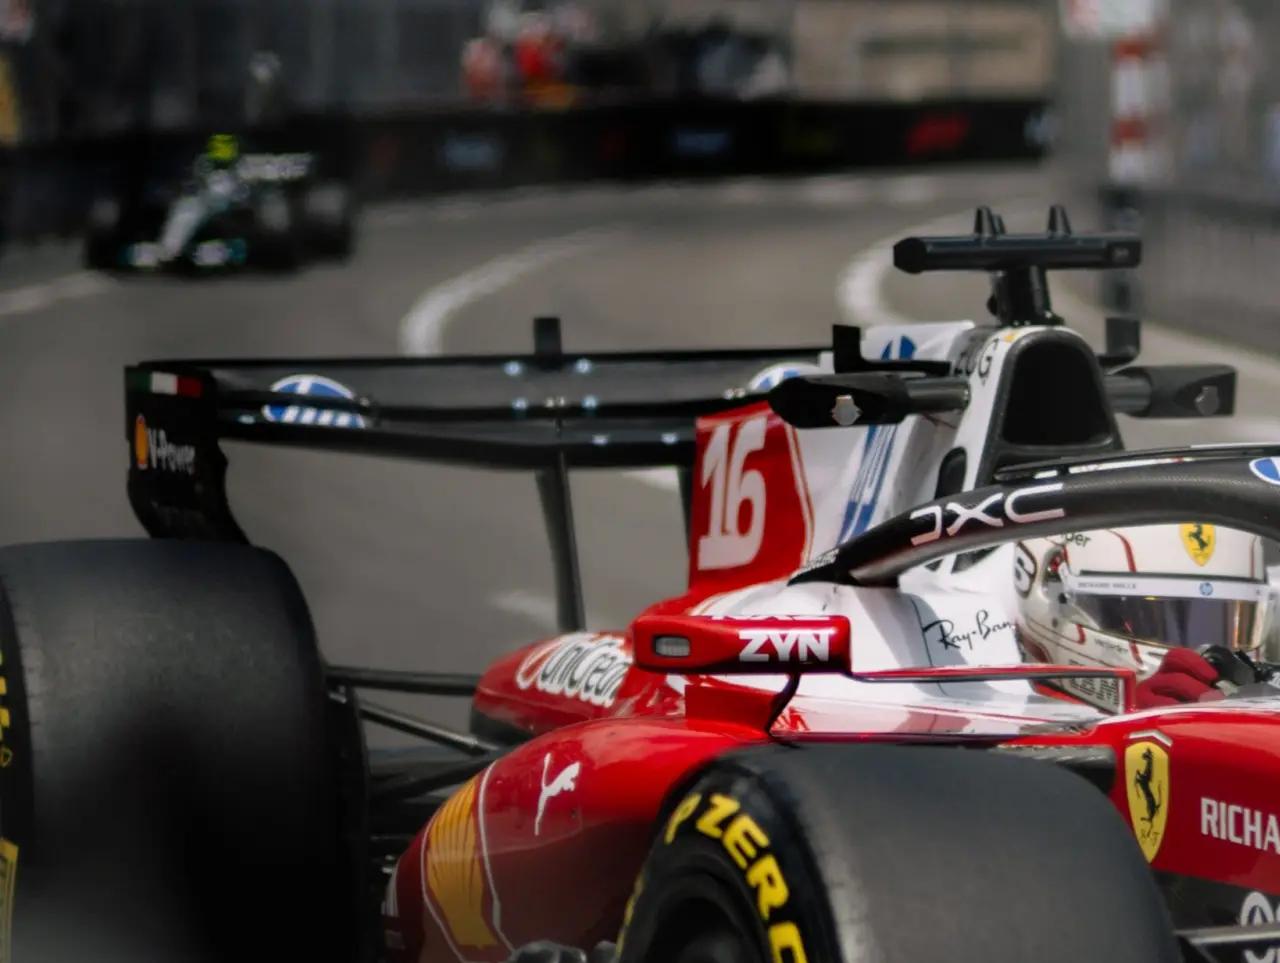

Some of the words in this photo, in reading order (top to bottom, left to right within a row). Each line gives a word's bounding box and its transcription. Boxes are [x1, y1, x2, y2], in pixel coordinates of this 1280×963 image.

[697, 417, 767, 571] 16
[910, 482, 1066, 546] DXC
[738, 629, 837, 662] ZYN
[921, 610, 1014, 650] Ray-Ban
[664, 792, 702, 845] P
